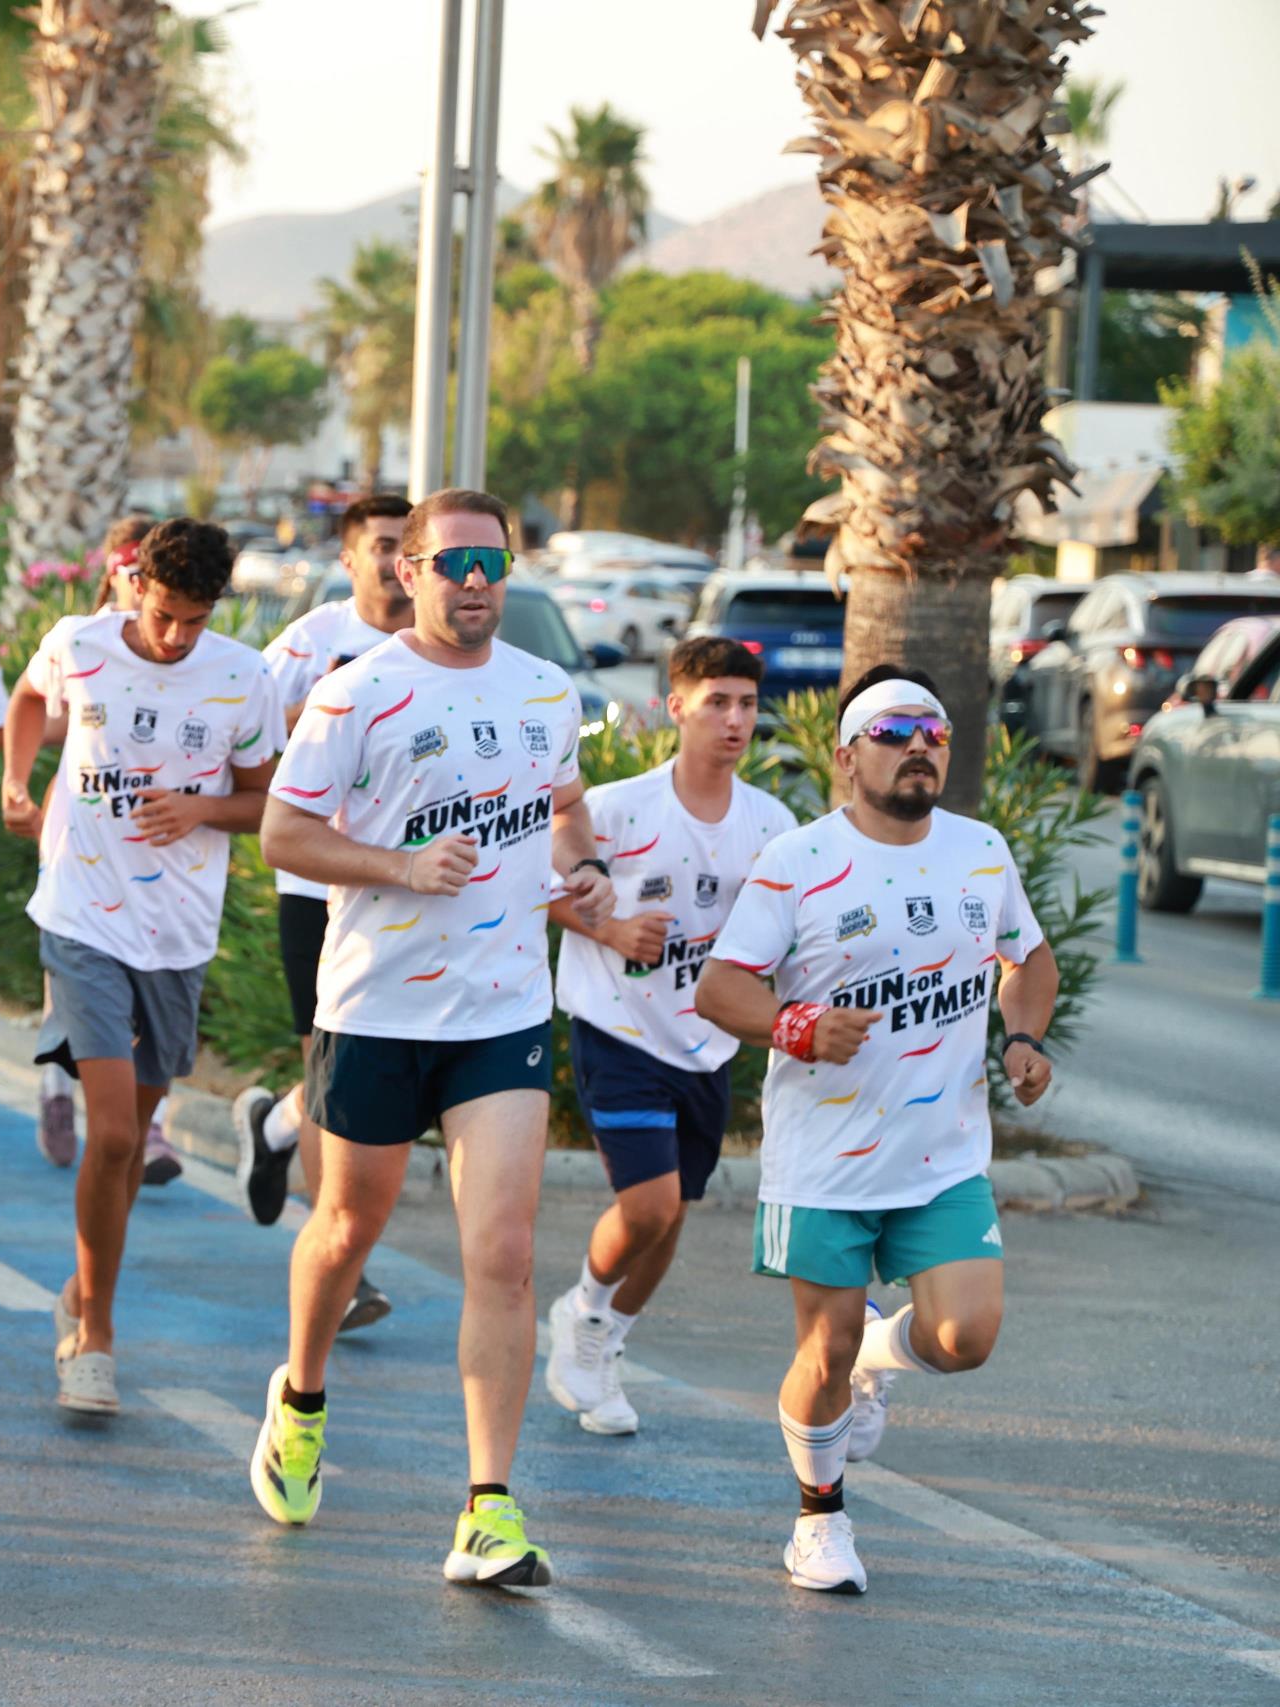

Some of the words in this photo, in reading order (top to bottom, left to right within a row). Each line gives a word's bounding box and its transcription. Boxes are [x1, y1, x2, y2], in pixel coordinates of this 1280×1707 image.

[525, 726, 545, 734] BASE
[530, 743, 548, 751] CLUB
[124, 774, 152, 789] FOR
[111, 783, 201, 818] EYN
[404, 796, 472, 844] RUN
[475, 794, 507, 820] FOR
[964, 902, 983, 911] BASE
[969, 921, 987, 929] CLUB
[907, 971, 943, 997] FOR
[891, 970, 987, 1033] EYMEN
